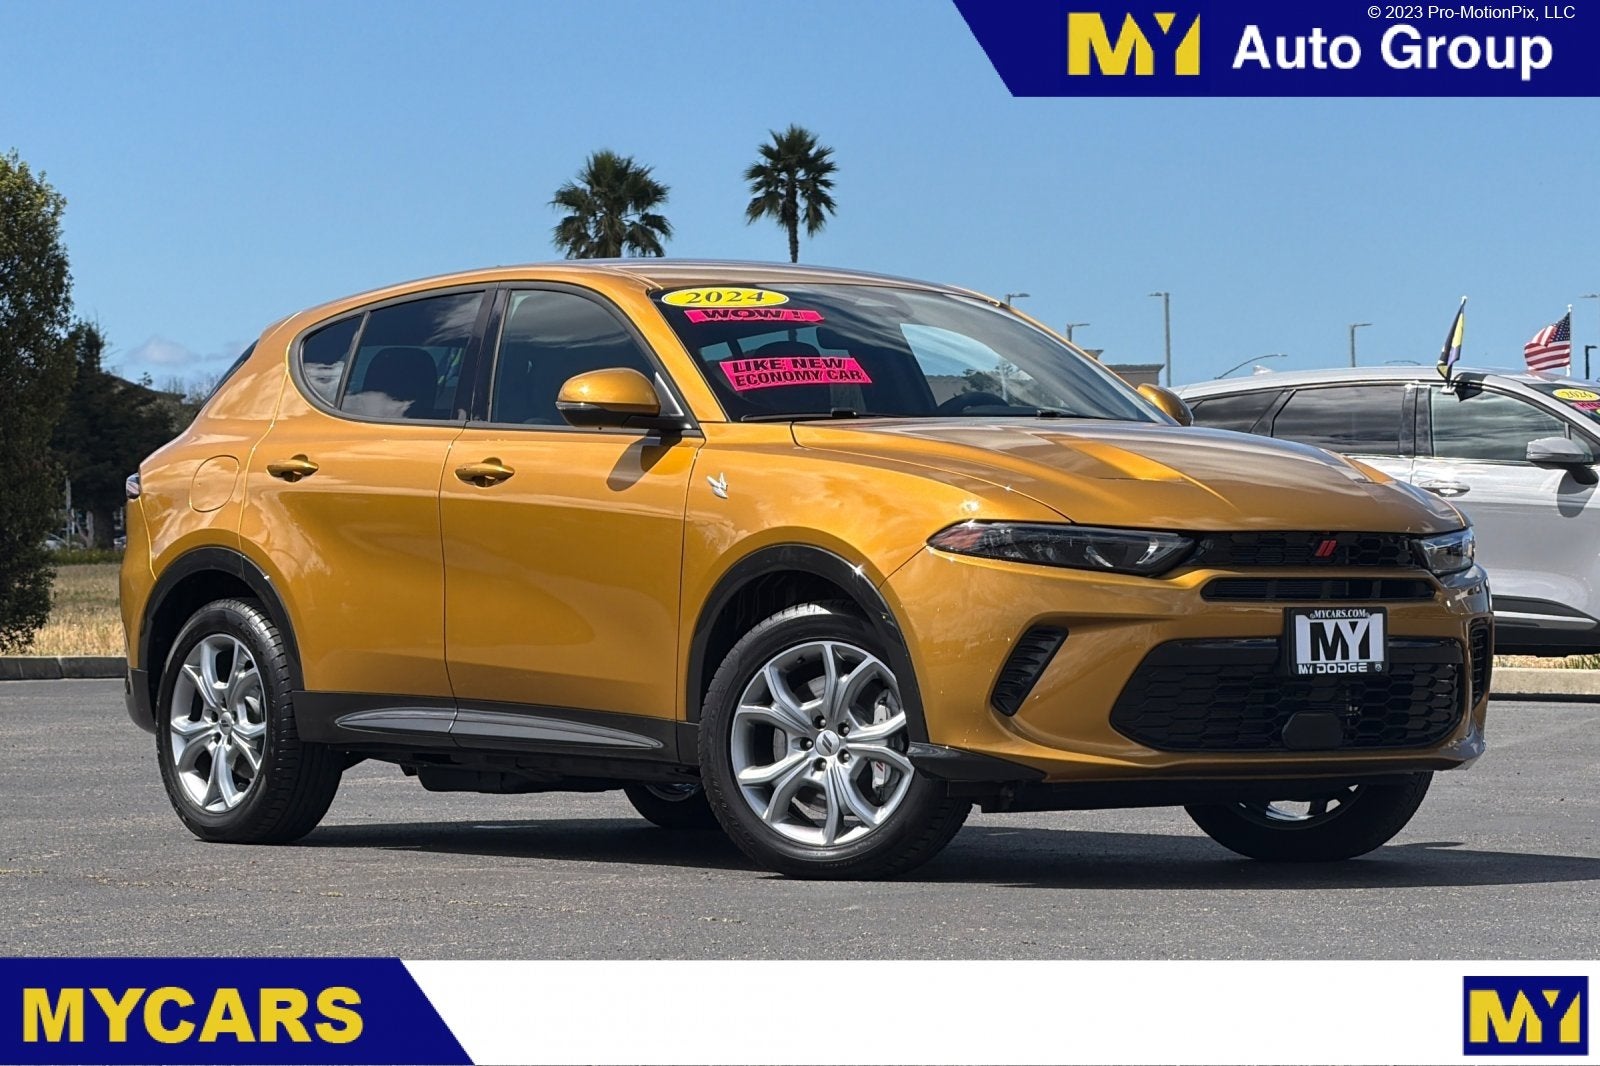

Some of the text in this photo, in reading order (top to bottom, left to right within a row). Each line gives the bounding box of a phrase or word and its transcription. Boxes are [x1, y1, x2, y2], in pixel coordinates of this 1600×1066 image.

[685, 291, 765, 304] 2024
[732, 358, 843, 373] LIKE NEW
[735, 369, 863, 386] ECONOMY CAR
[1314, 609, 1367, 618] MYCARS.COM
[1309, 621, 1370, 661] MY
[1298, 662, 1367, 674] MY DODGE
